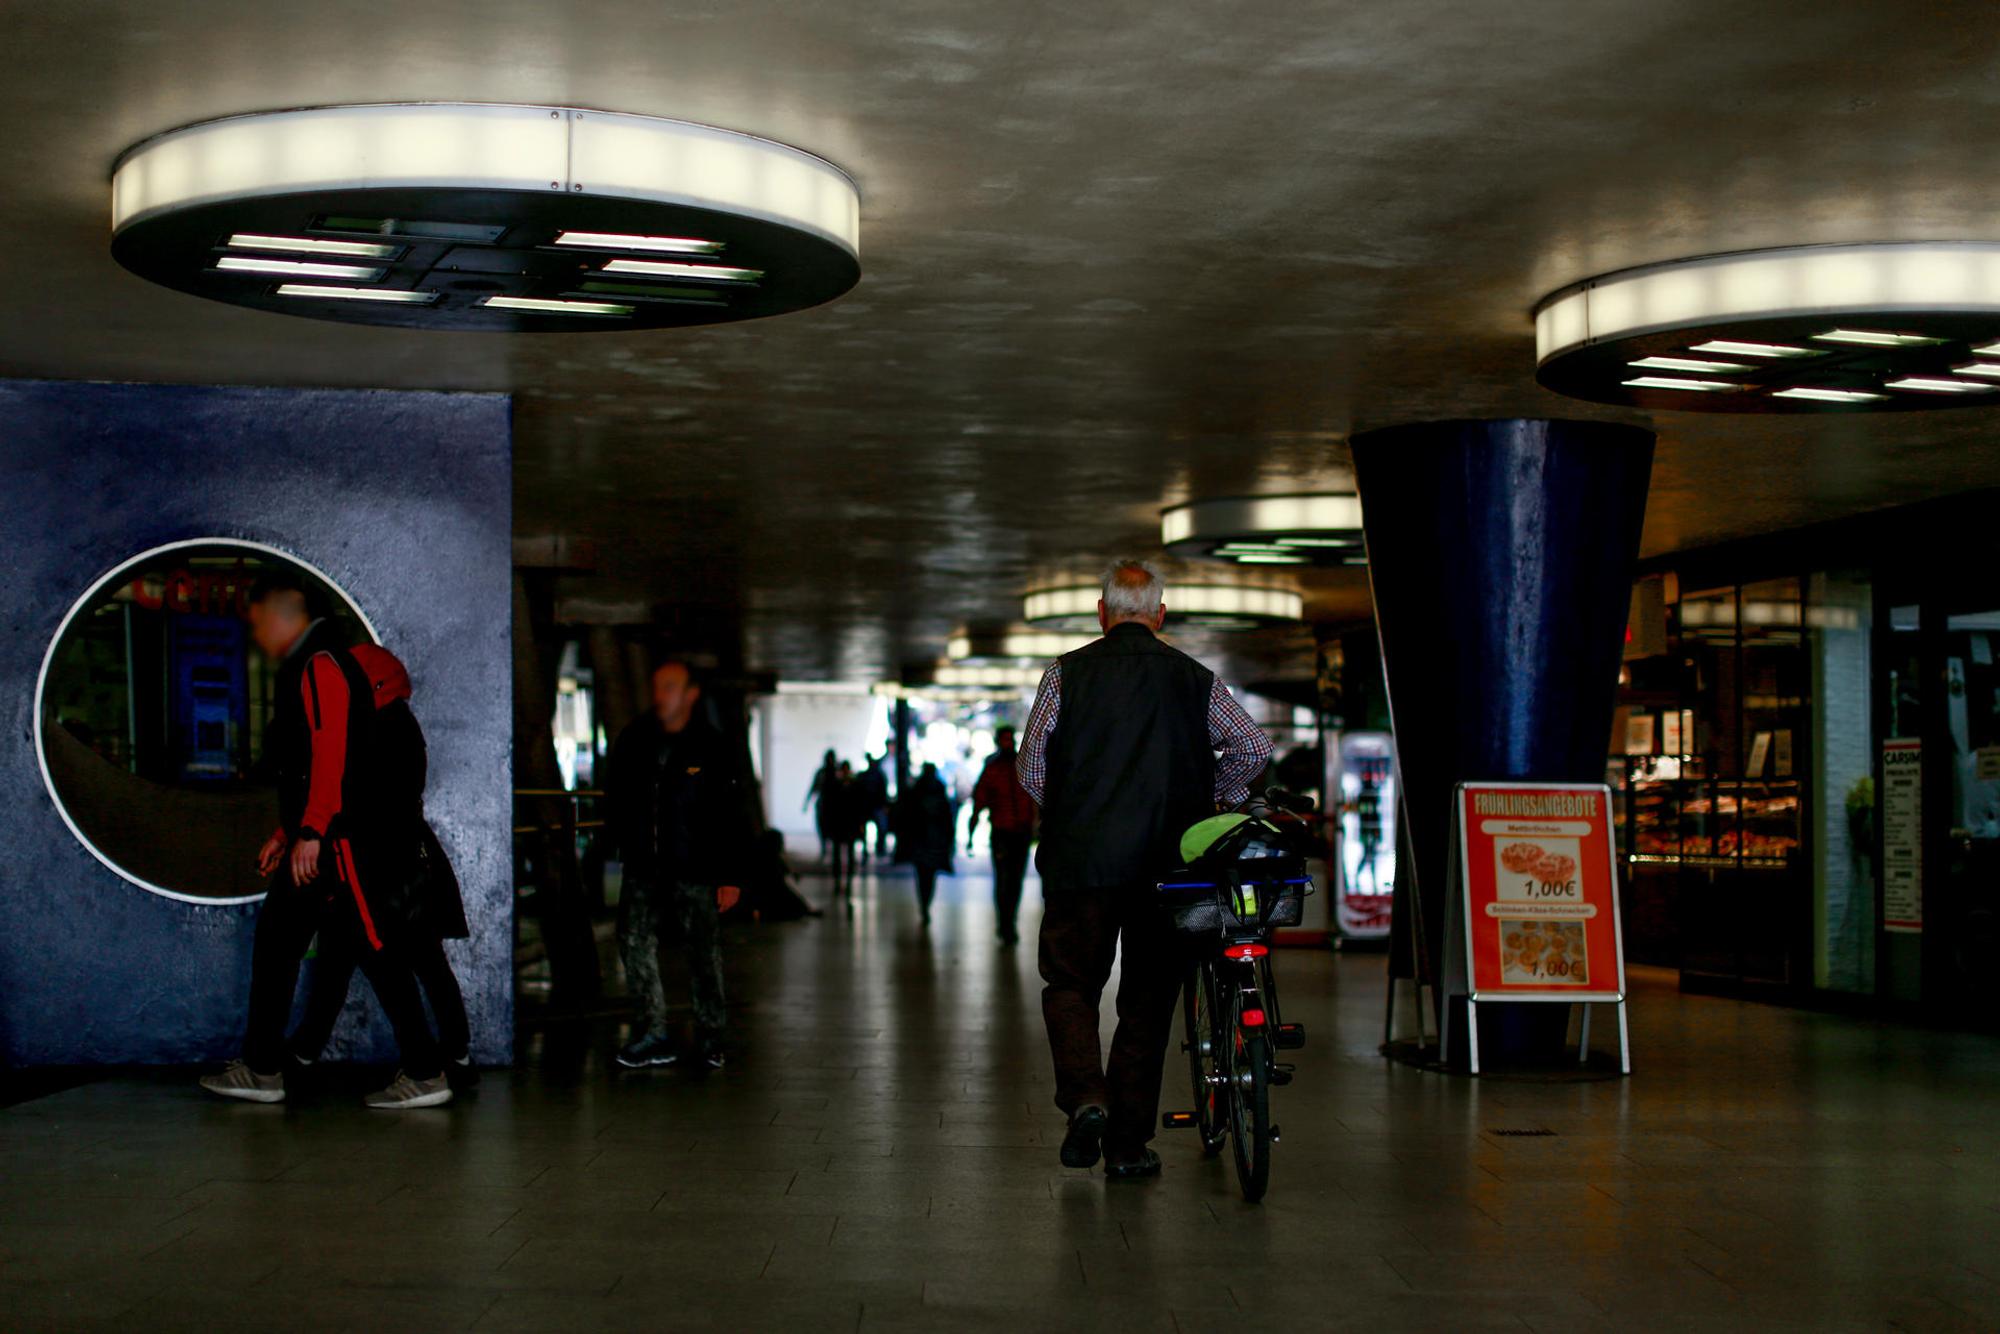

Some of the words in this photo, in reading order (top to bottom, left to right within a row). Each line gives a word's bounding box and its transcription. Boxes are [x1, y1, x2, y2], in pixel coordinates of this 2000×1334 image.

[1474, 791, 1597, 817] FRÜHLINGSANGEBOTE
[1524, 880, 1576, 898] 1,00€
[1532, 960, 1585, 979] 1,00€
